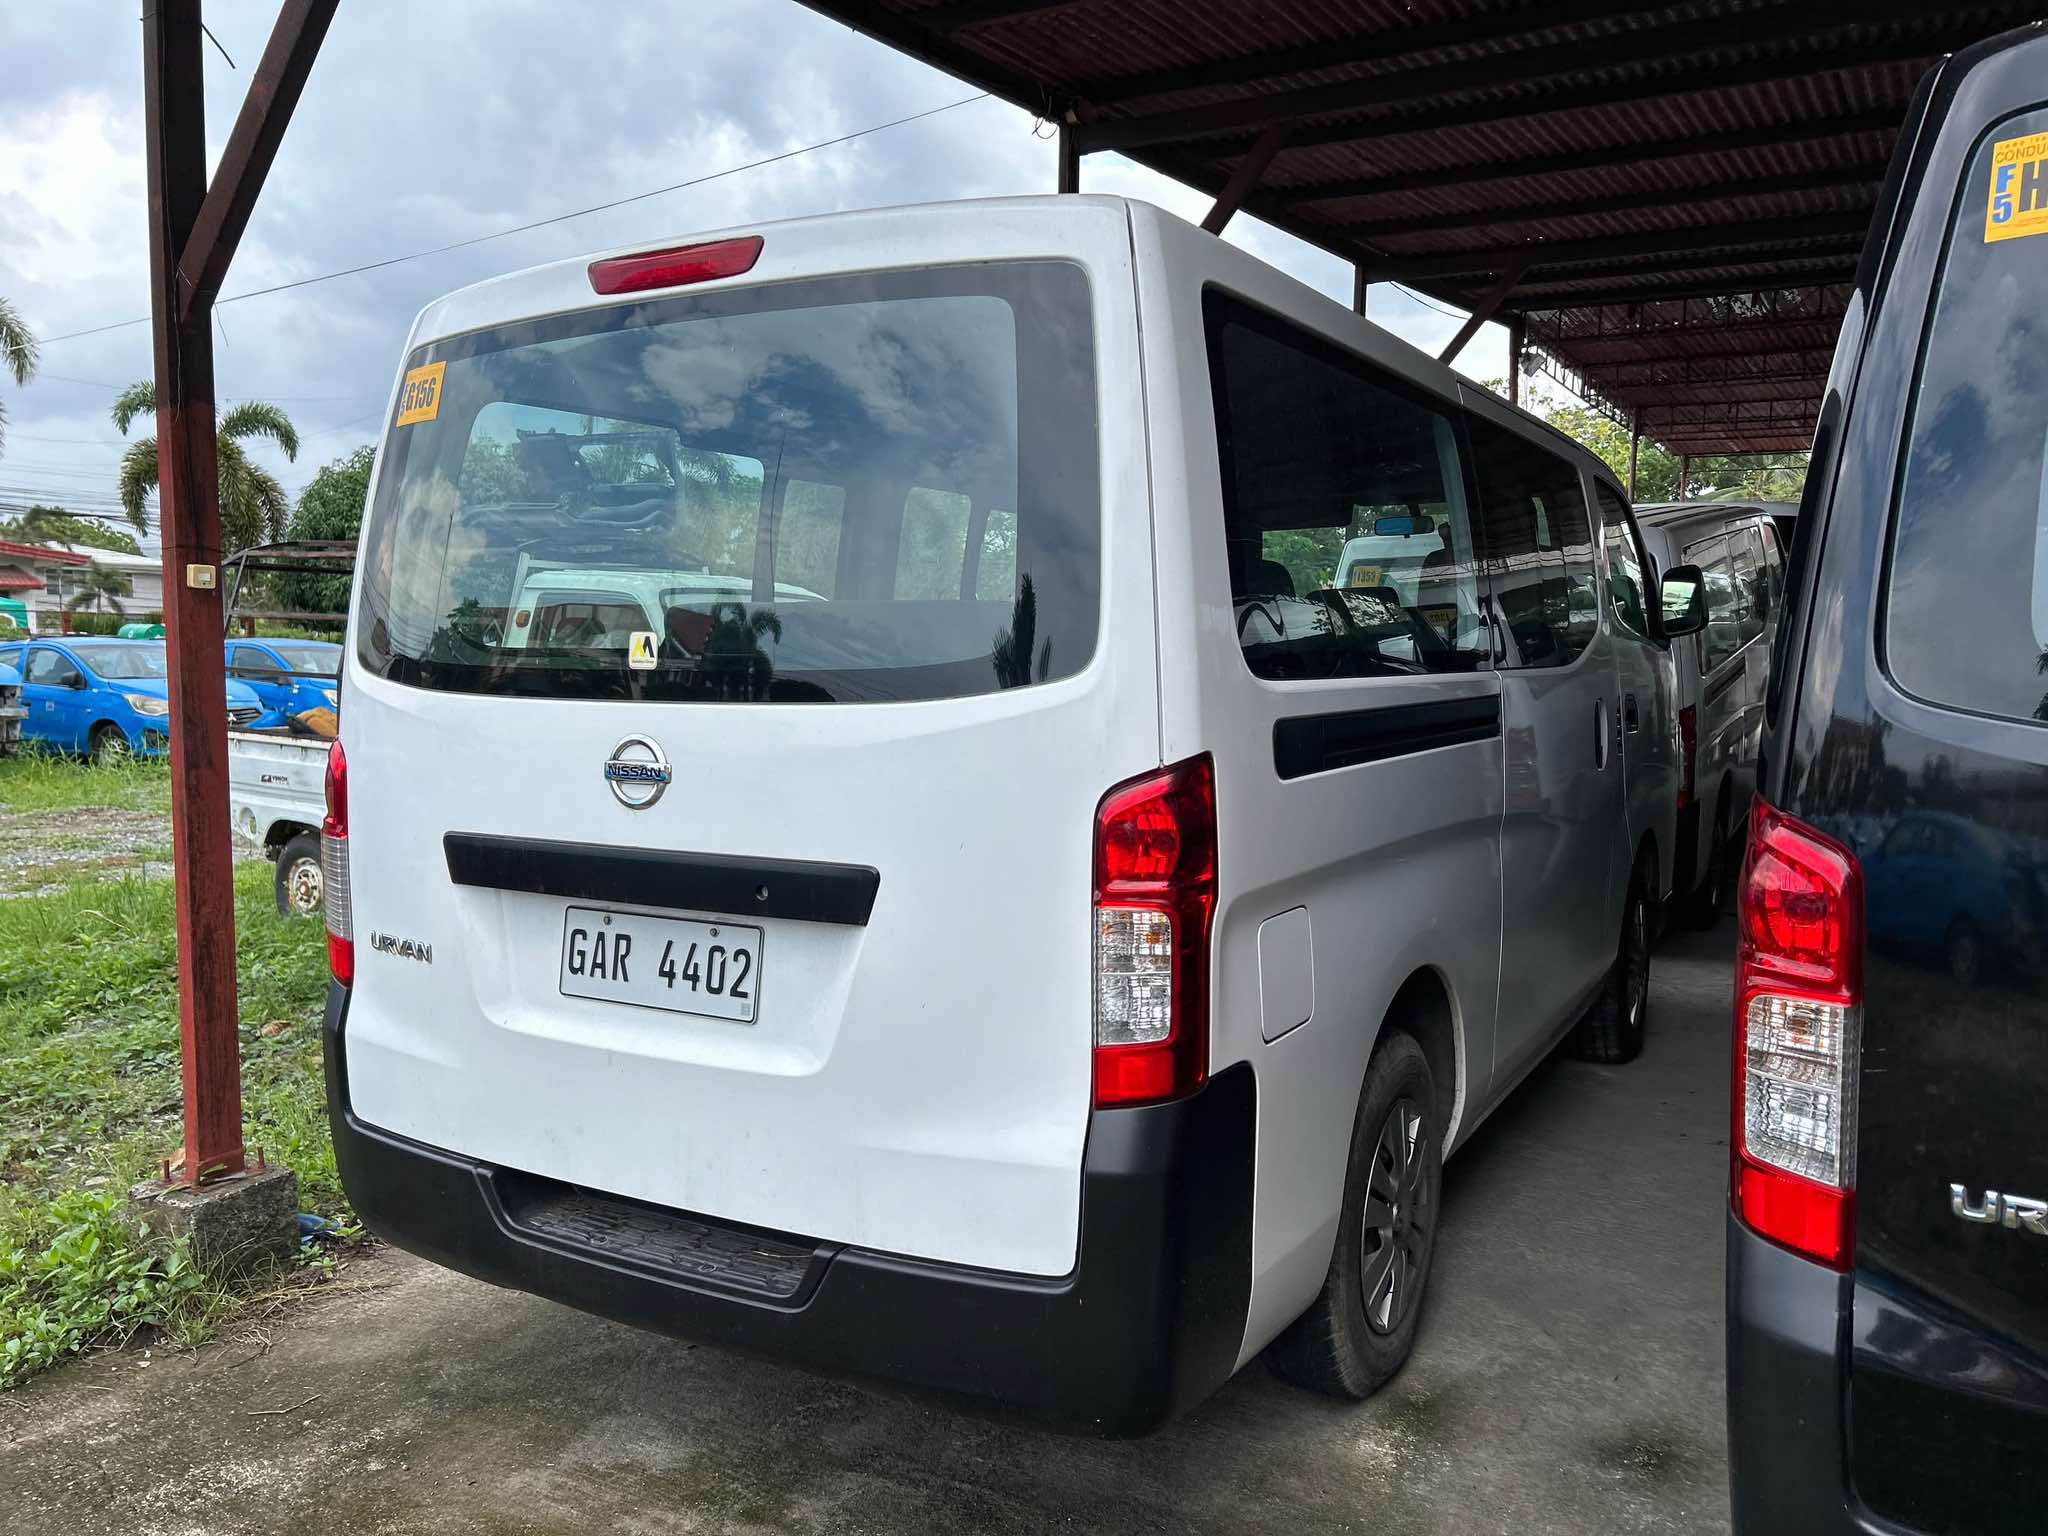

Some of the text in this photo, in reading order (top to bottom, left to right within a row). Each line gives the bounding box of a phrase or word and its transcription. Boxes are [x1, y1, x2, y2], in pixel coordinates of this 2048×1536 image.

[1995, 143, 2048, 163] CONDU
[1995, 163, 2016, 193] F
[1992, 194, 2013, 224] 5
[607, 764, 661, 778] NISSAN
[370, 930, 433, 965] URVAN
[568, 928, 752, 999] GAR 4402
